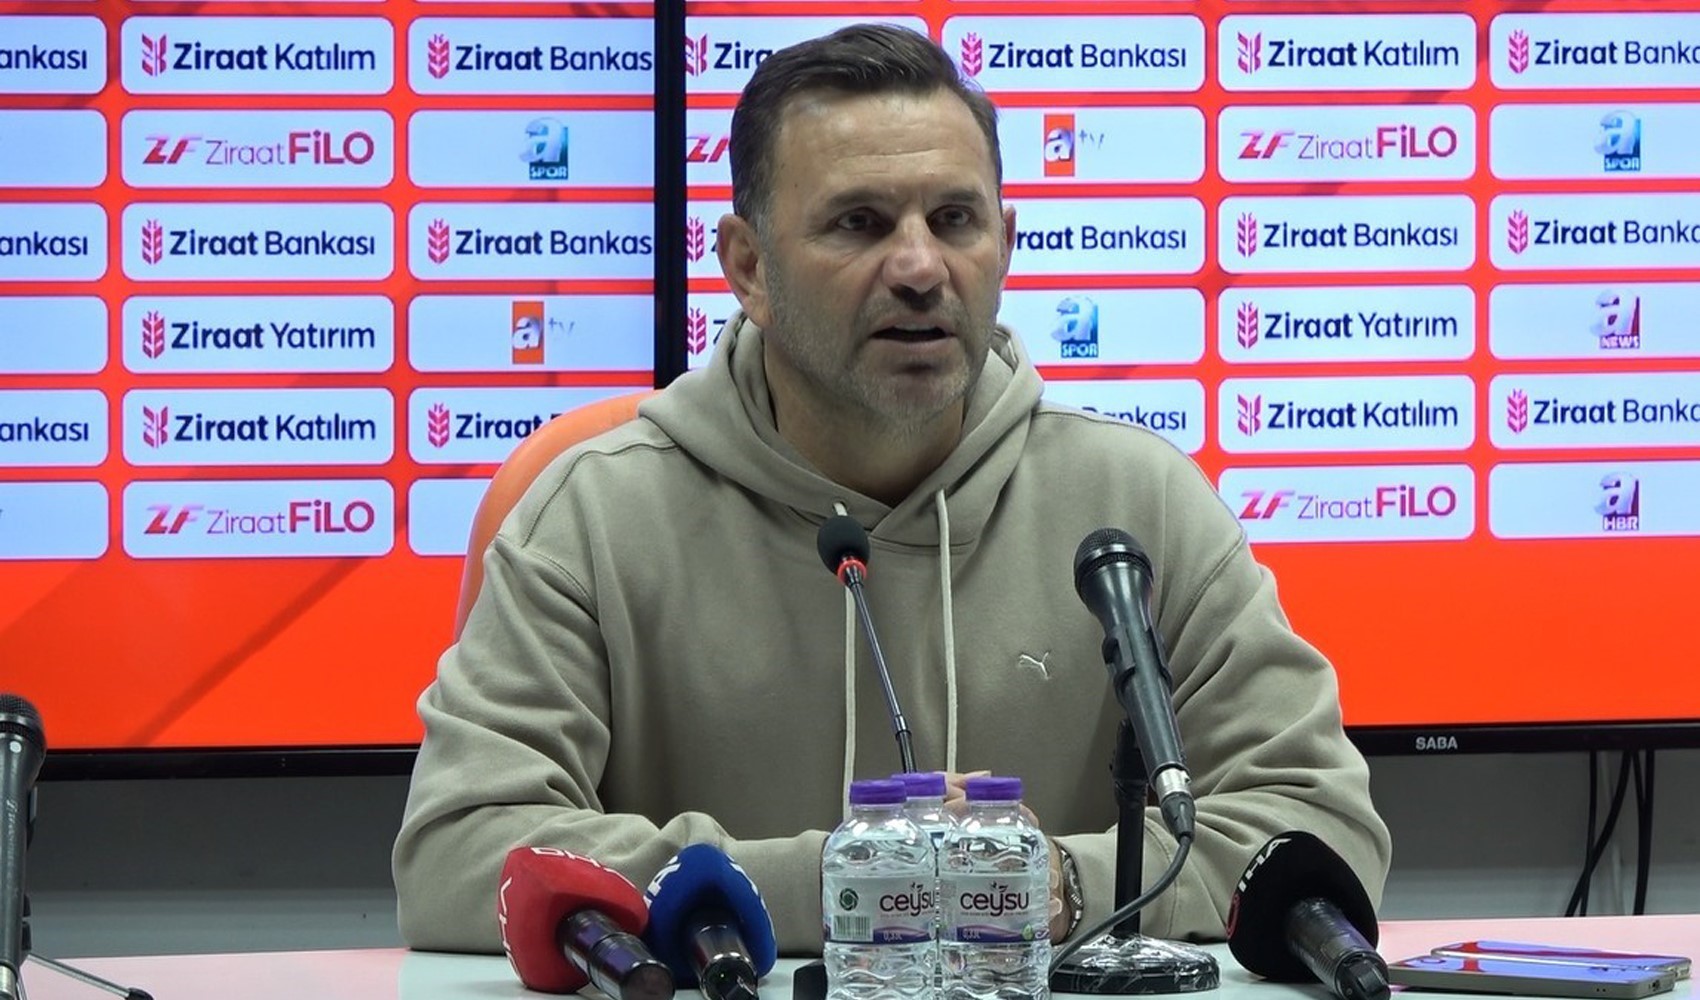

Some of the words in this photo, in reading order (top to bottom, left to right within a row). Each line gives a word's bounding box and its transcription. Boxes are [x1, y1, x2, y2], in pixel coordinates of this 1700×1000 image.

[0, 44, 87, 69] ankası
[173, 41, 268, 70] Ziraat
[275, 43, 375, 70] Katılım
[455, 44, 543, 70] Ziraat
[551, 46, 652, 71] Bankas
[989, 42, 1073, 68] Ziraat
[1081, 44, 1186, 68] Bankası
[1268, 39, 1357, 67] Ziraat
[1364, 40, 1459, 66] Katılım
[1535, 39, 1617, 65] Ziraat
[1625, 41, 1700, 64] Banka
[206, 140, 284, 165] Ziraat
[1298, 135, 1372, 159] Ziraat
[0, 231, 88, 256] ankası
[170, 229, 258, 256] Ziraat
[265, 230, 375, 255] Bankası
[456, 228, 543, 255] Ziraat
[551, 230, 652, 255] Bankas
[1016, 226, 1074, 250] raat
[1082, 225, 1186, 250] Bankası
[1264, 222, 1347, 248] Ziraat
[1354, 222, 1458, 247] Bankası
[1534, 219, 1617, 244] Ziraat
[1624, 220, 1700, 244] Banka
[171, 321, 264, 349] Ziraat
[270, 322, 375, 349] Yatırım
[1265, 312, 1353, 339] Ziraat
[1358, 312, 1457, 338] Yatırım
[1062, 343, 1097, 356] SPOR
[1267, 401, 1357, 429] Ziraat
[1364, 400, 1458, 428] Katılım
[1534, 398, 1616, 424] Ziraat
[1623, 398, 1700, 423] Banka
[0, 417, 88, 442] ankası
[174, 413, 268, 441] Ziraat
[276, 413, 376, 441] Katılım
[1298, 496, 1372, 519] Ziraat
[207, 510, 285, 534] Ziraat
[1604, 516, 1638, 529] HBR
[1415, 736, 1458, 750] SABA
